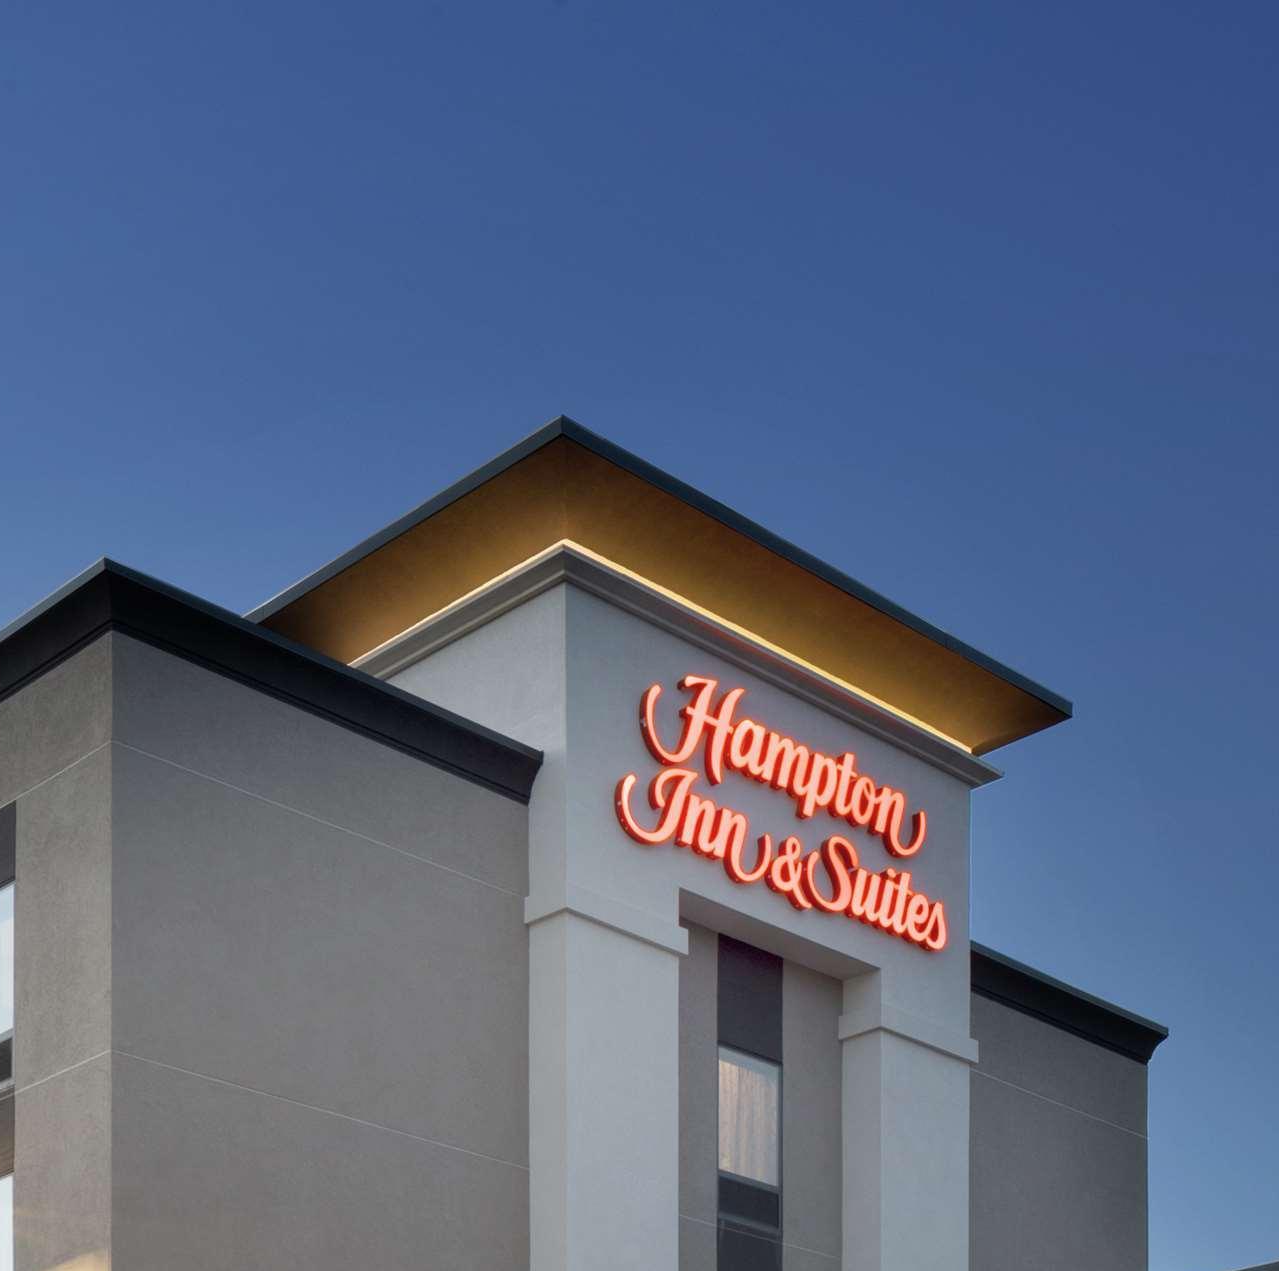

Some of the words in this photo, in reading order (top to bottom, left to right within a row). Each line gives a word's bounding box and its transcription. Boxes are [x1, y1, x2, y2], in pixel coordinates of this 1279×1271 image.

[640, 675, 927, 857] Hampton
[616, 767, 772, 883] Inn
[766, 835, 812, 910] &
[806, 835, 948, 951] Suites
